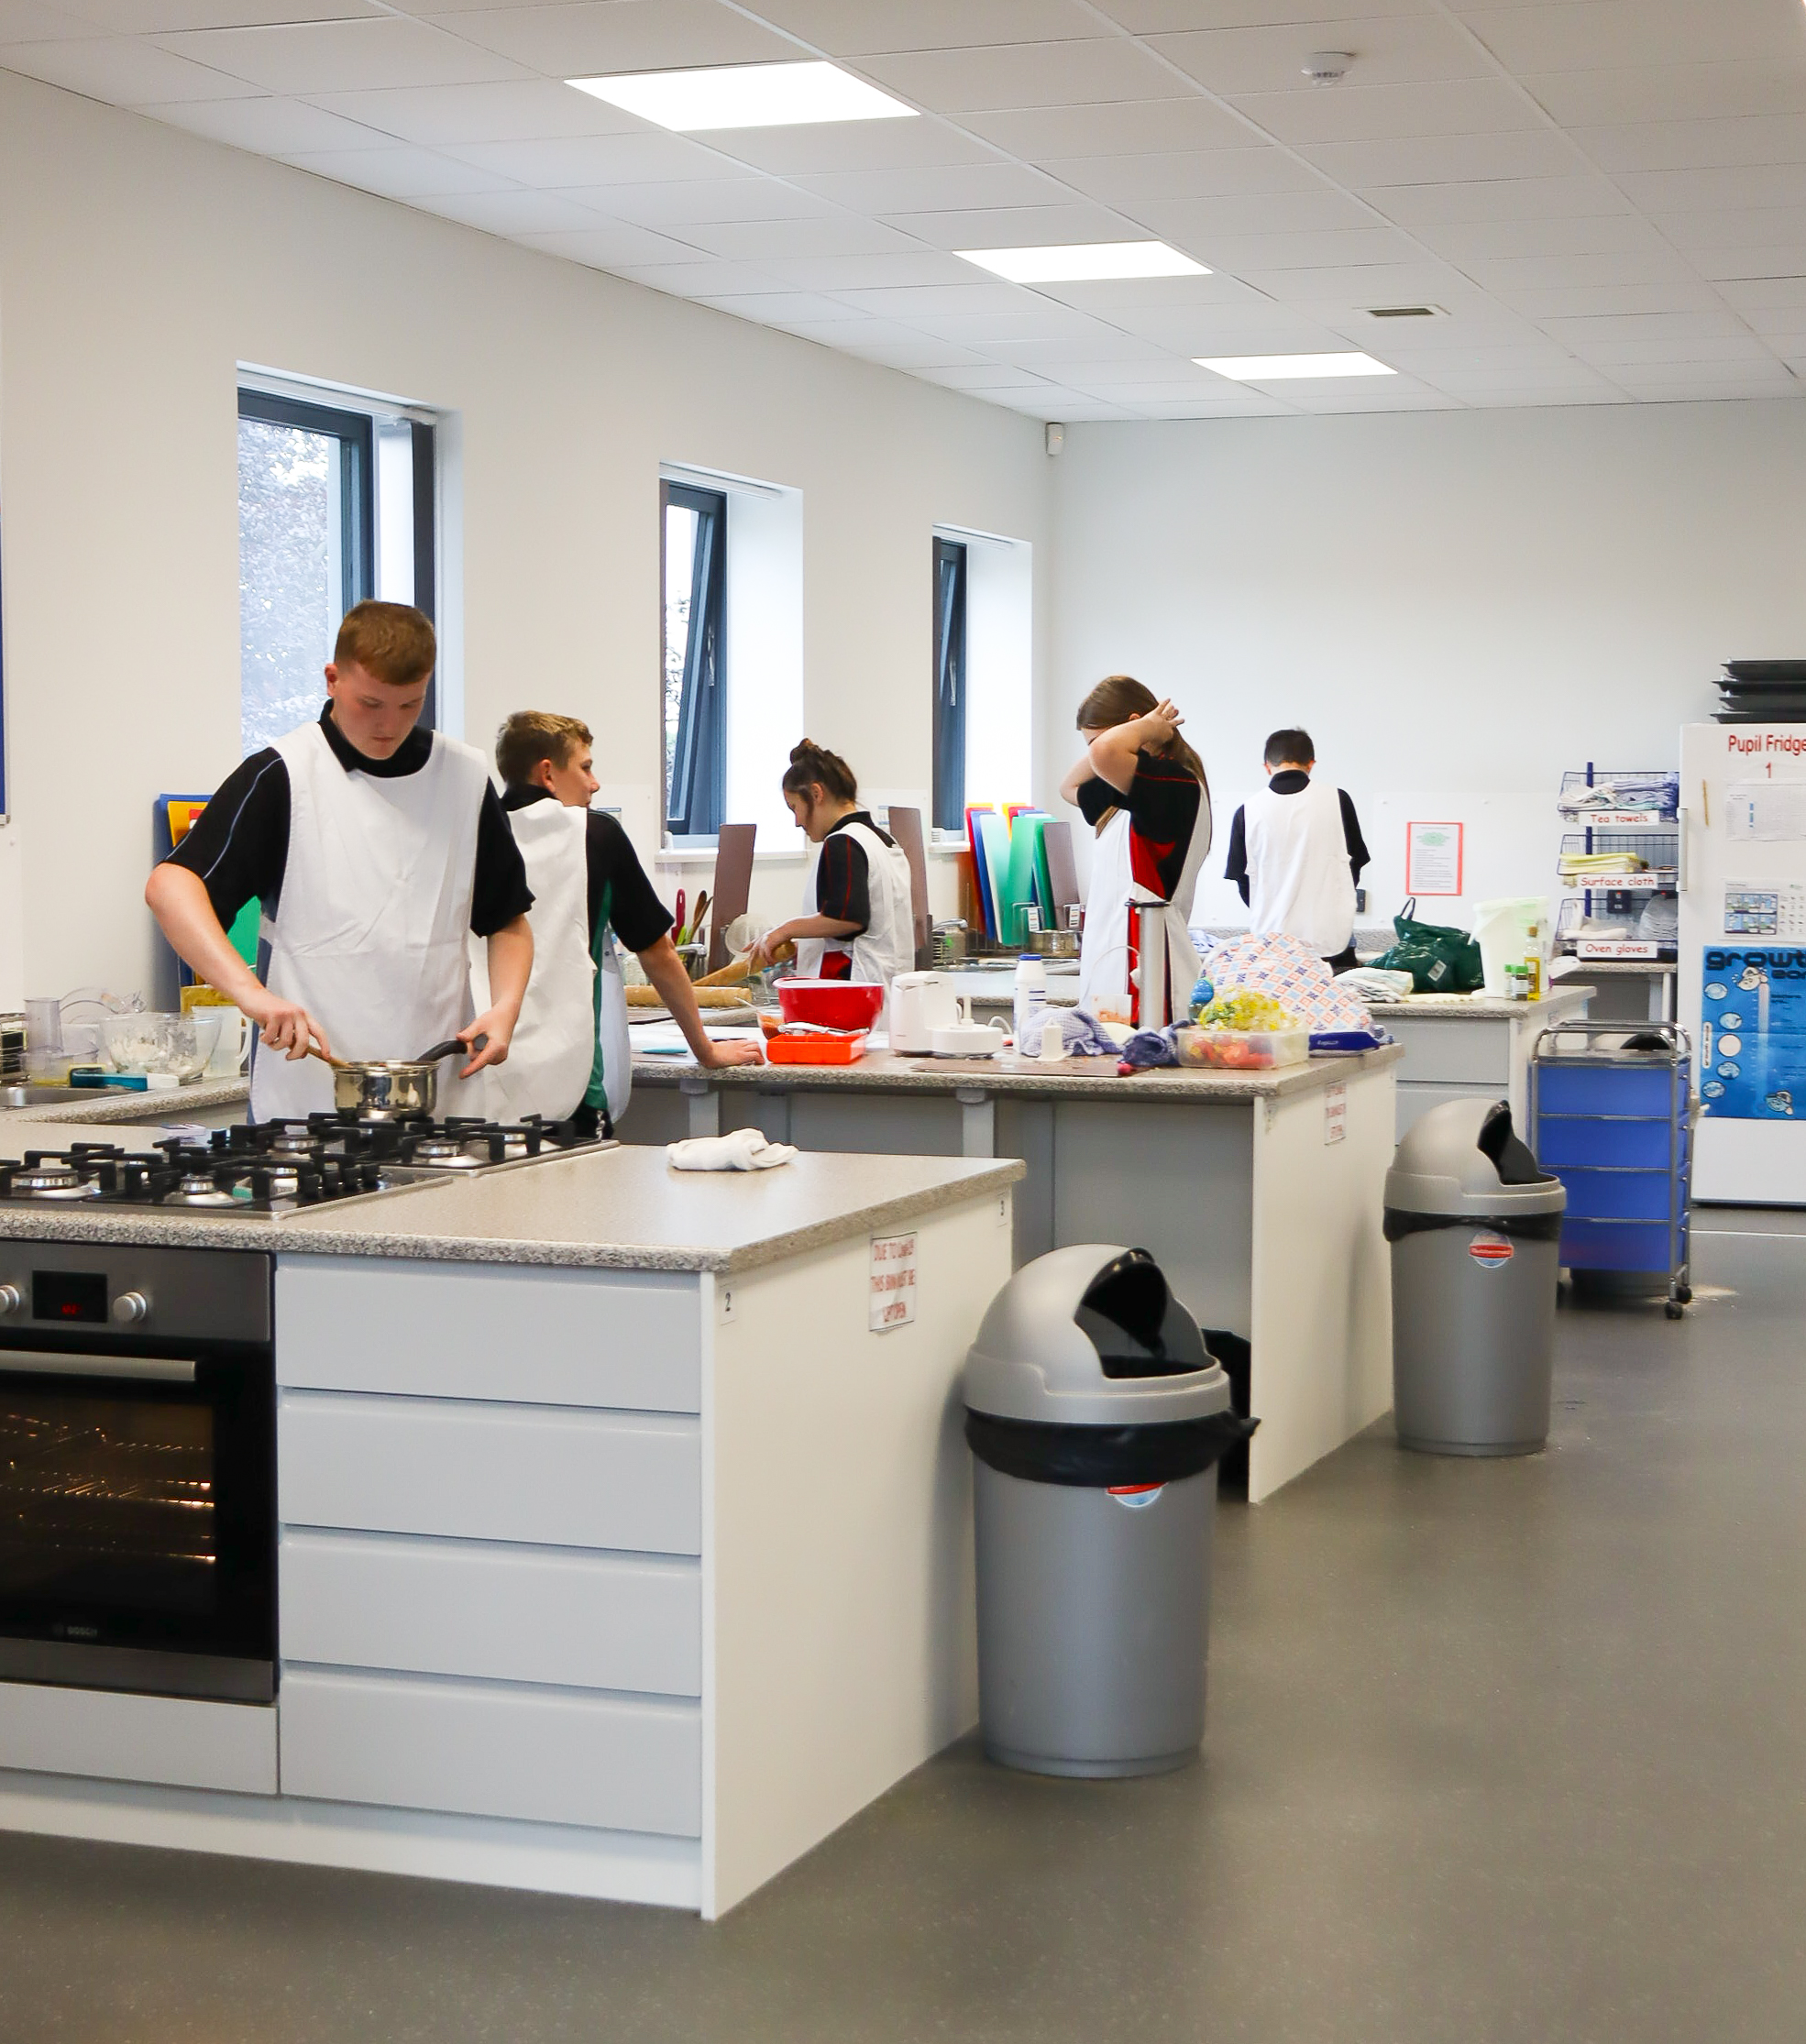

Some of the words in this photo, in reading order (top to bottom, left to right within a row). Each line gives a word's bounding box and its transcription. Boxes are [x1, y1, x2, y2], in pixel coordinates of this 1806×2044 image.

[1728, 734, 1761, 756] Pupil
[1766, 733, 1806, 756] Fridge
[1765, 762, 1771, 778] 1
[1591, 814, 1610, 823] Tea
[1615, 812, 1648, 823] towels
[1580, 876, 1623, 886] Surface
[1628, 876, 1655, 886] cloth
[1585, 943, 1612, 953] Oven
[1616, 943, 1648, 956] gloves
